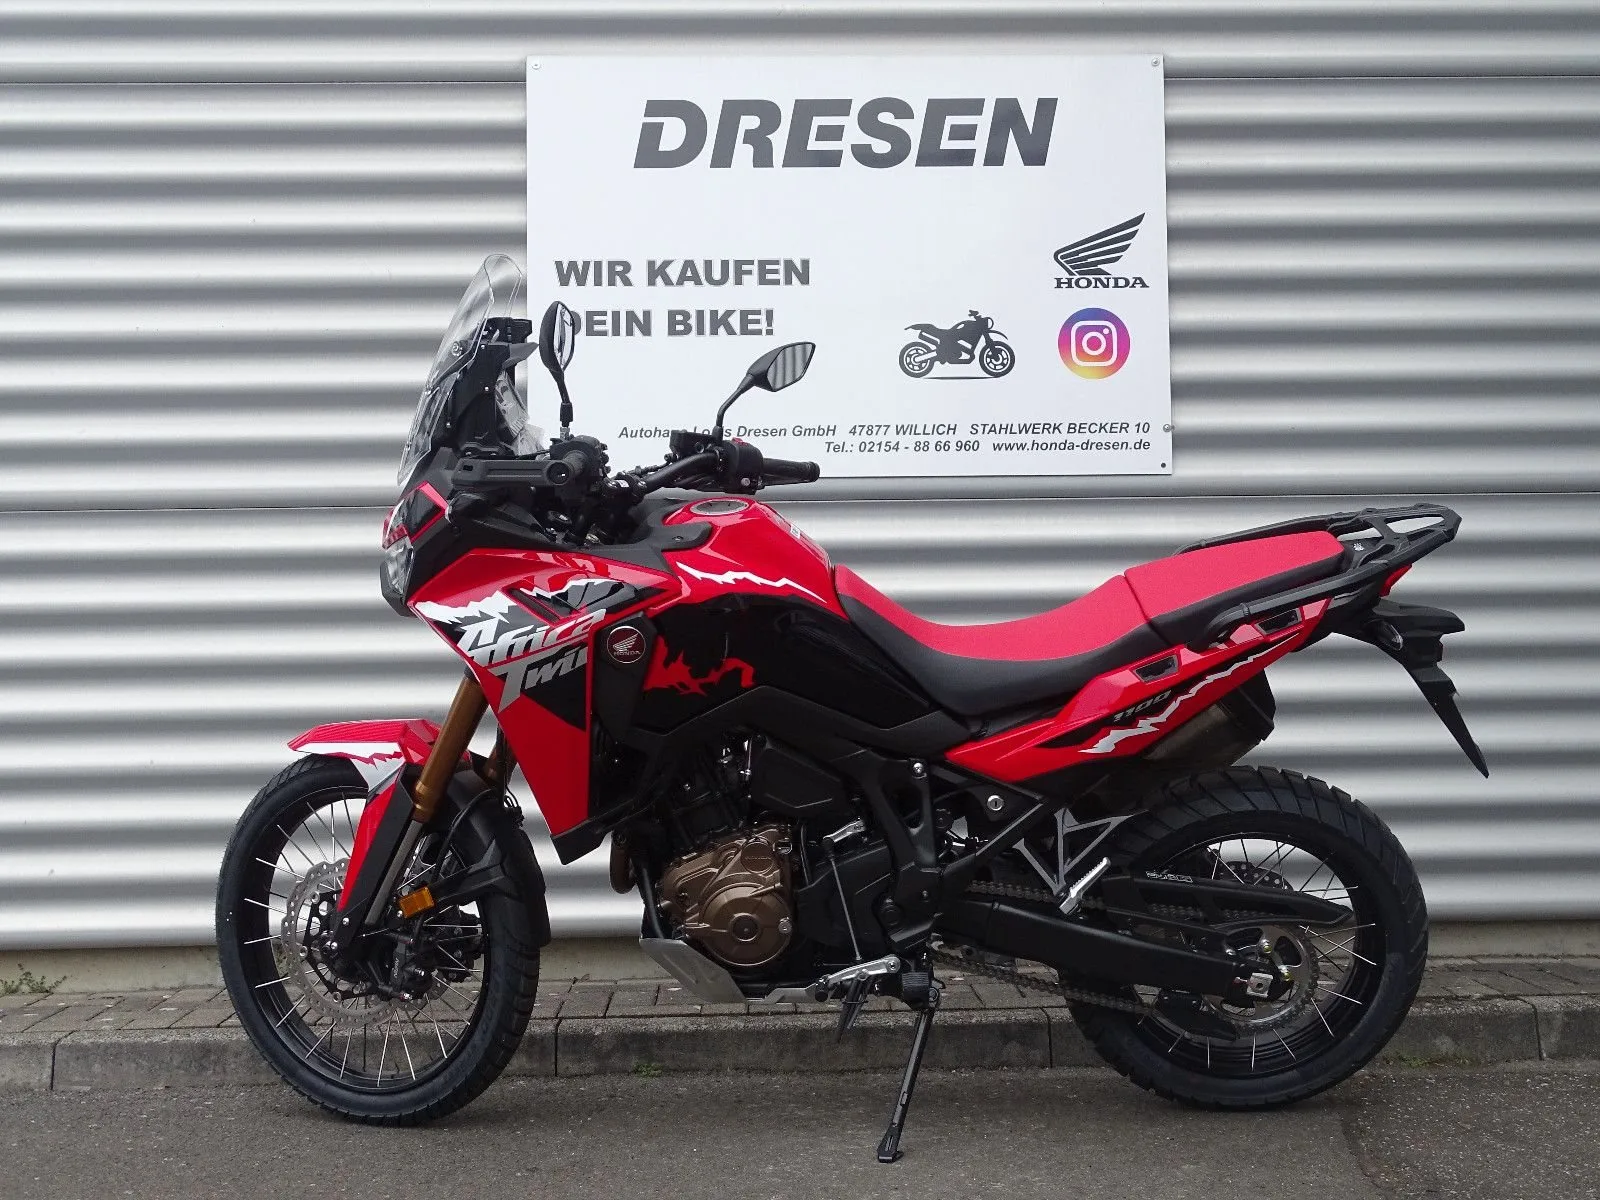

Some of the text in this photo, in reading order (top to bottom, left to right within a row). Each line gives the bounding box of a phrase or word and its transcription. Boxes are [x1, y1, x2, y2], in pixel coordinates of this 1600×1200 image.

[634, 97, 1058, 168] DRESEN
[554, 259, 810, 287] WIR KAUFEN
[1054, 276, 1149, 289] HONDA
[667, 309, 774, 336] BIKE!
[618, 426, 670, 439] Autoha
[736, 425, 787, 437] Dresen
[791, 424, 837, 437] GmbH
[848, 424, 891, 437] 47877
[895, 423, 958, 436] WILLICH
[969, 422, 1063, 435] STAHLWERK
[1066, 422, 1130, 435] BECKER
[1134, 421, 1151, 434] 10
[824, 441, 854, 453] Tel.:
[858, 440, 900, 453] 02154
[913, 440, 930, 452] 88
[934, 440, 951, 452] 66
[955, 440, 980, 452] 960
[992, 438, 1151, 452] www.honda-dresen.de
[456, 609, 607, 667] Africa
[1113, 690, 1172, 722] 1100
